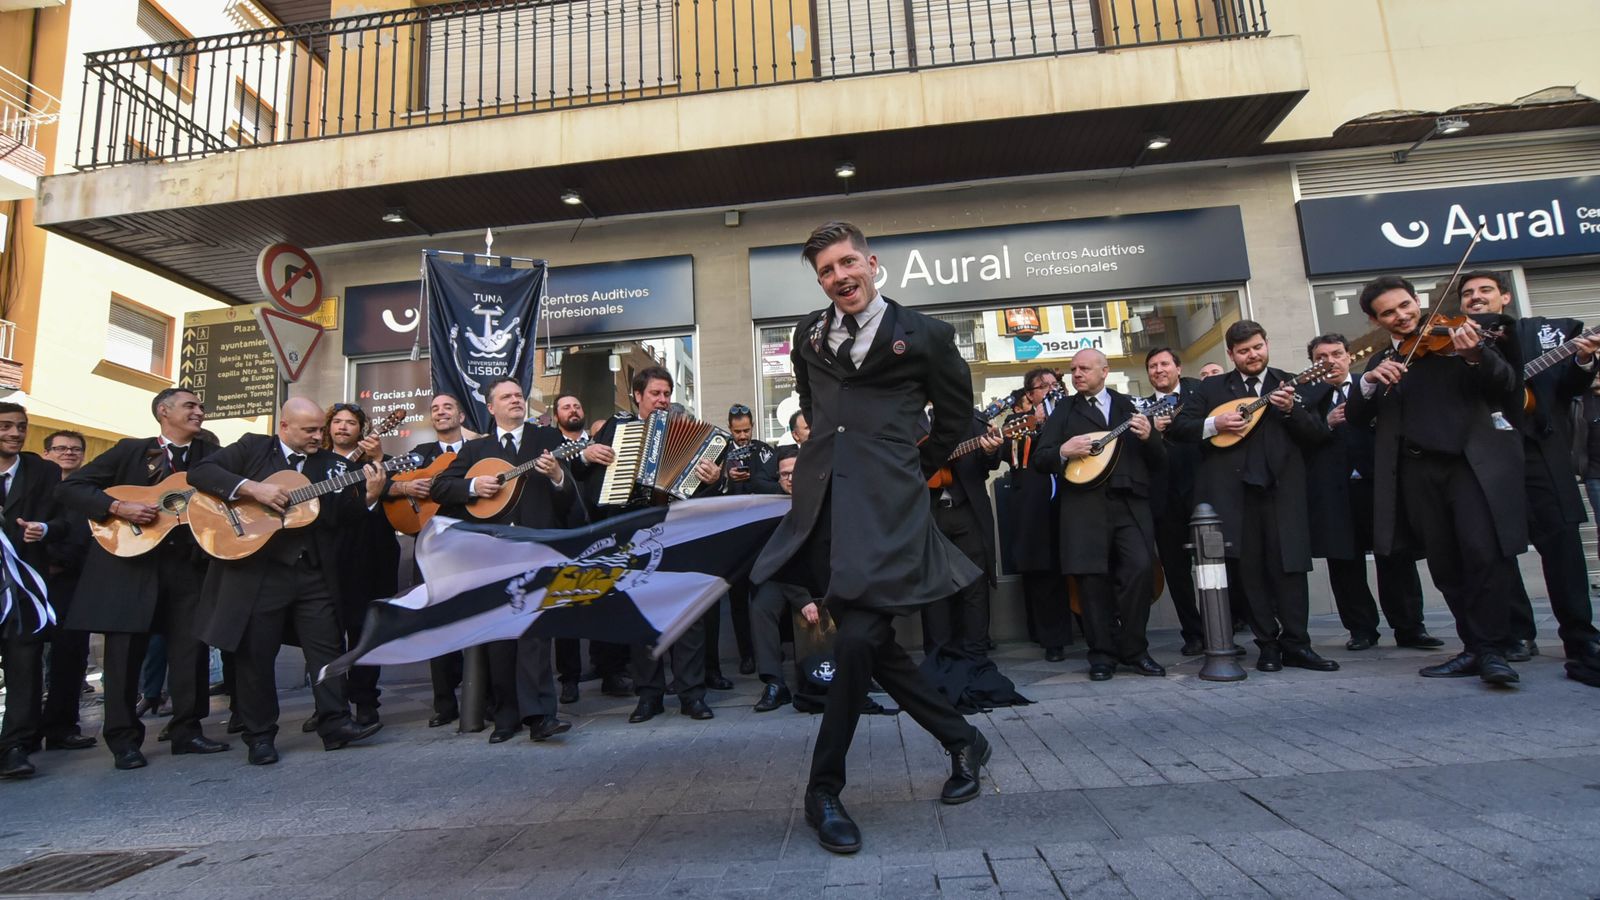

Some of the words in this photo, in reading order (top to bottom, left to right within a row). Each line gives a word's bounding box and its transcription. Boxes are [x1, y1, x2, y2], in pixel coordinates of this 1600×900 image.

[1443, 199, 1565, 245] Aural
[1024, 250, 1078, 263] Centros
[1081, 244, 1145, 258] Auditivos
[900, 244, 1011, 288] Aural
[1026, 261, 1118, 277] Profesionales
[473, 293, 503, 303] TUNA
[540, 293, 589, 306] Centros
[591, 288, 650, 302] Auditivos
[541, 304, 624, 320] Profesionales
[233, 324, 256, 333] Plaza
[220, 339, 268, 351] ayuntamien
[254, 358, 275, 366] Palma
[467, 366, 508, 376] LISBOA
[251, 374, 275, 382] Europa
[245, 383, 274, 391] mercado
[250, 390, 274, 398] Torroja
[372, 390, 405, 400] Gracias
[407, 390, 413, 398] a
[372, 405, 386, 413] me
